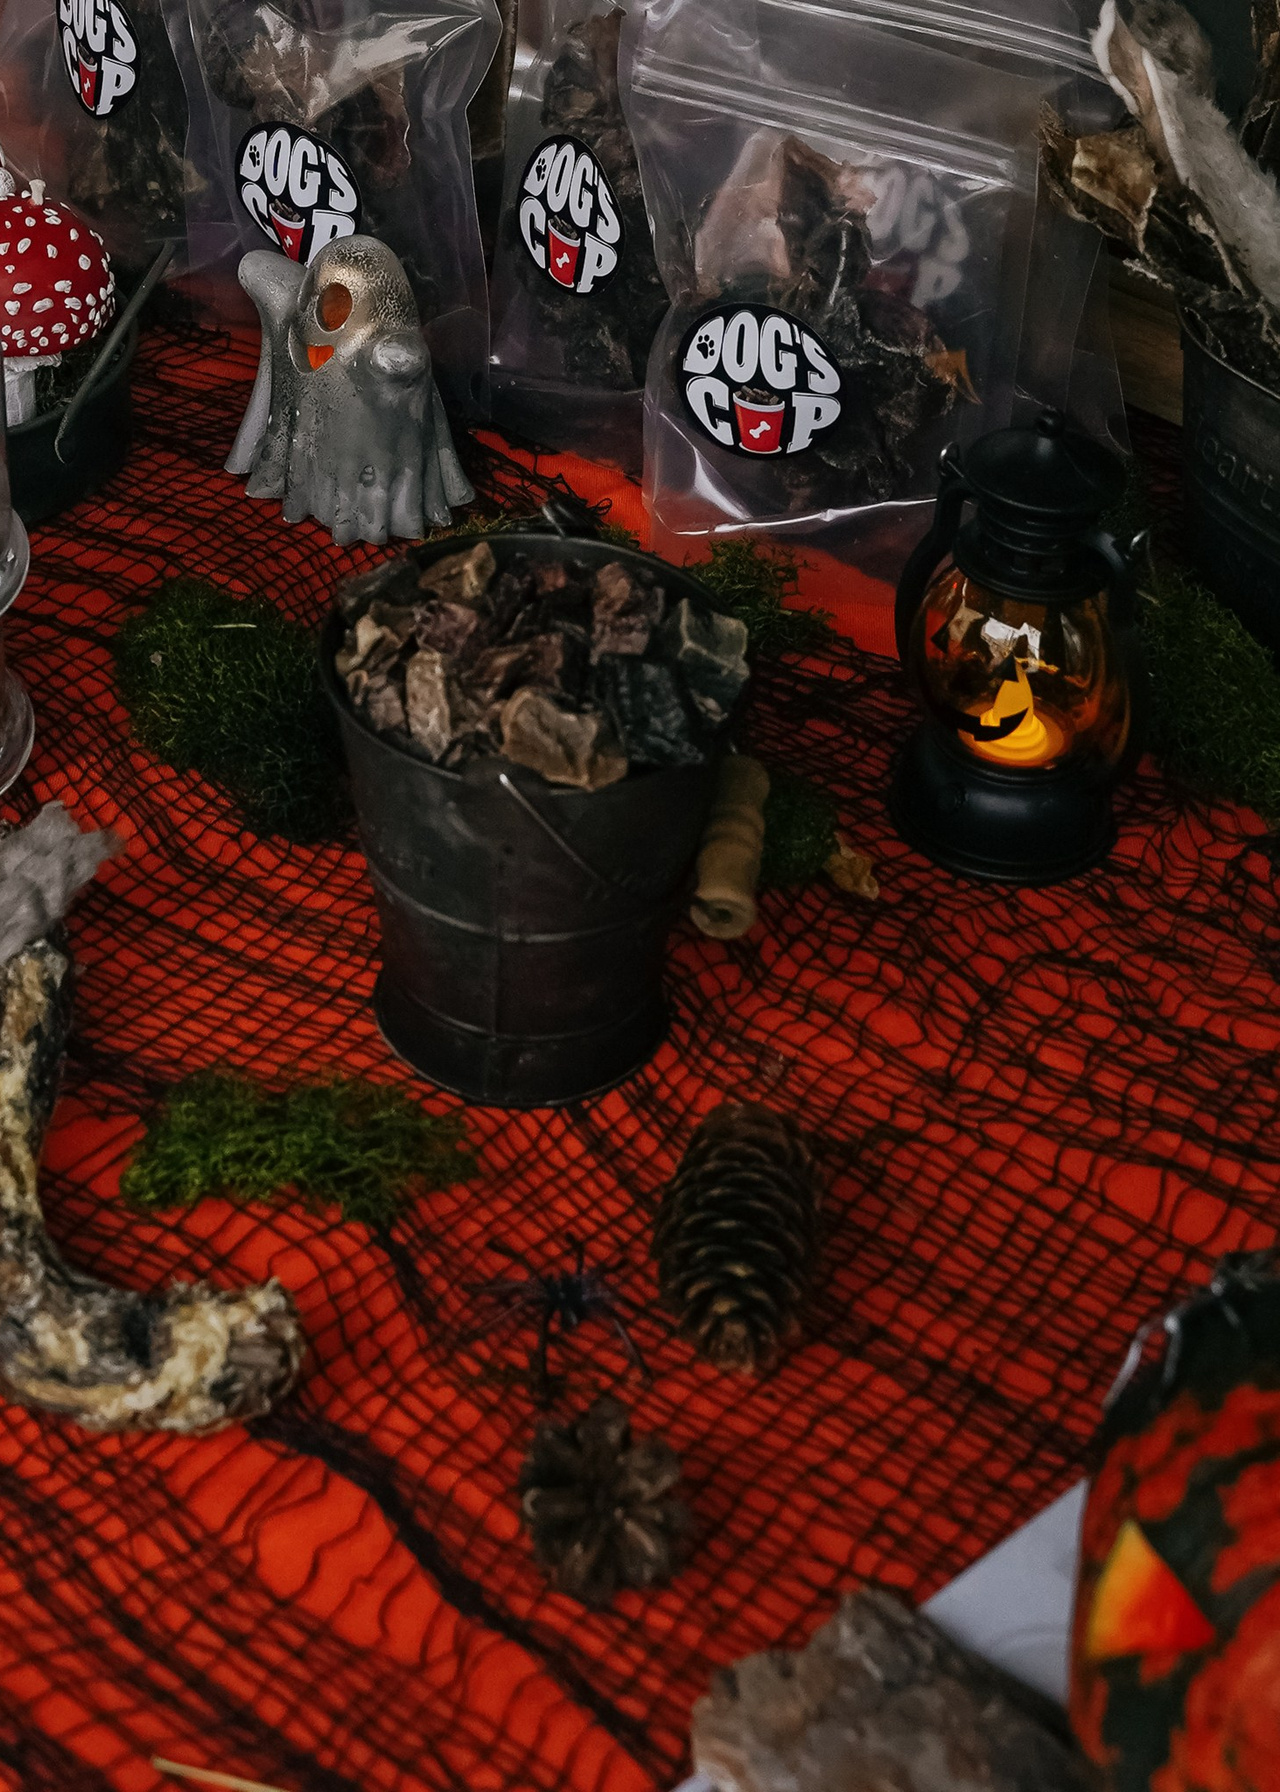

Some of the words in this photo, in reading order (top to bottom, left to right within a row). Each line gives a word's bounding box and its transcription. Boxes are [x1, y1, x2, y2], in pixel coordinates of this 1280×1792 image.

[239, 127, 358, 213] DOG'S
[523, 142, 620, 244] DOG'S
[683, 309, 841, 395] DOG'S
